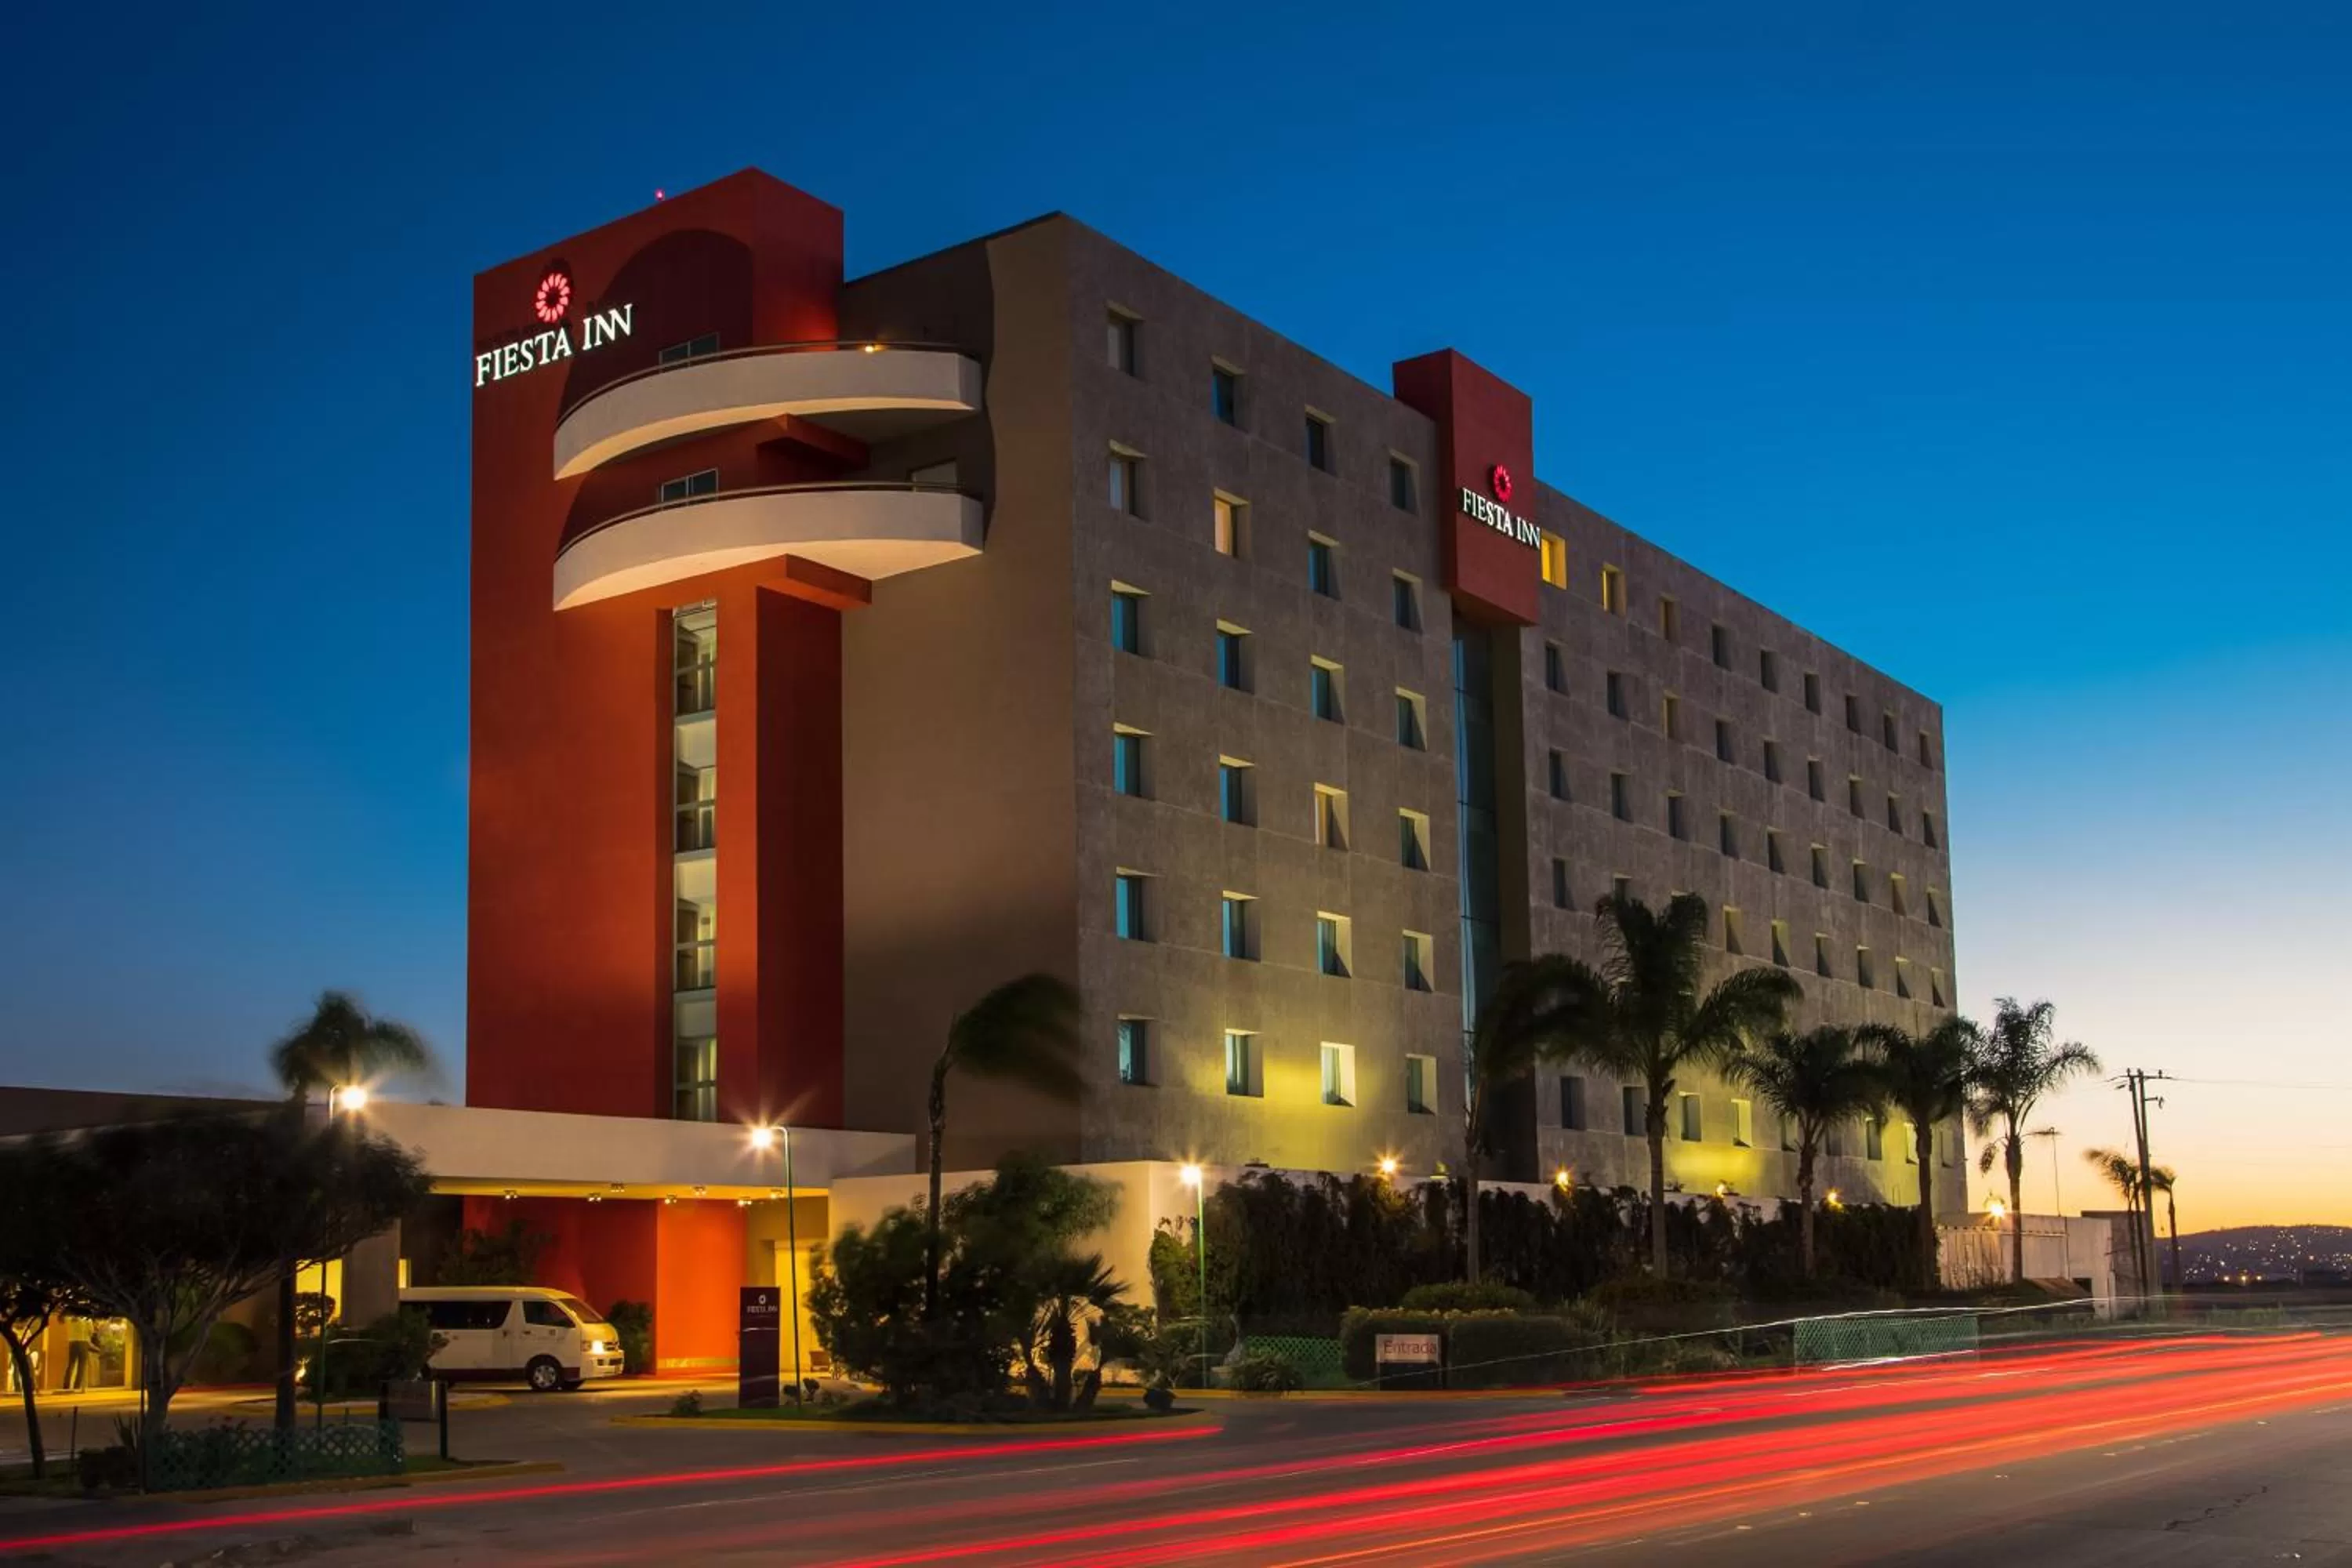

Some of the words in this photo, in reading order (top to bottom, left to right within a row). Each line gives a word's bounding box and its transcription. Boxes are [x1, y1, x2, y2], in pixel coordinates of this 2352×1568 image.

[475, 327, 572, 387] FIESTA
[582, 303, 633, 350] INN
[1462, 487, 1513, 537] FIESTA
[1516, 516, 1541, 549] INN
